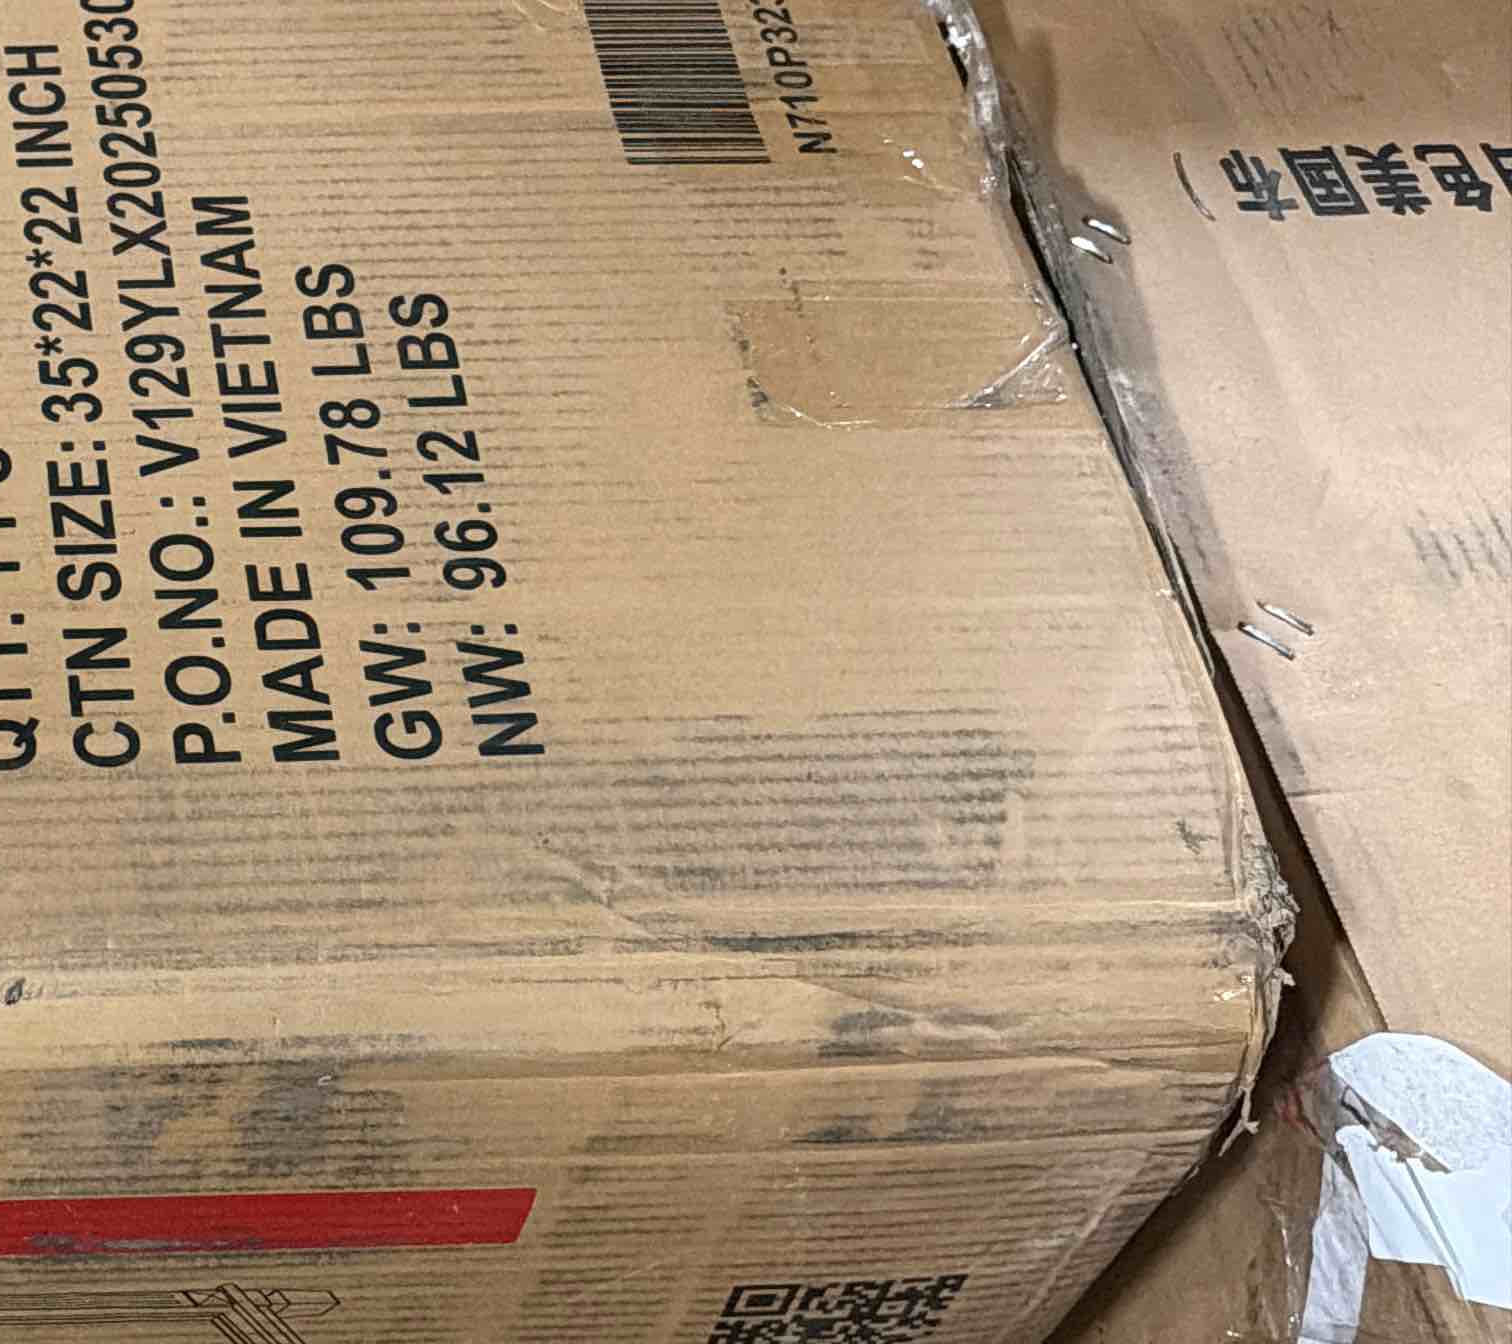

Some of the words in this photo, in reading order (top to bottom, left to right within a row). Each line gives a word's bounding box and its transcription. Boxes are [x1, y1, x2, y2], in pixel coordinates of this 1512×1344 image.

[3, 44, 74, 168] INCH
[191, 195, 288, 458] VIETNAM
[294, 262, 373, 377] LBS
[388, 292, 469, 408] LBS
[45, 440, 123, 602] SIZE:
[232, 479, 304, 538] IN
[318, 397, 411, 591] 109.78
[415, 429, 508, 591] 96.12
[61, 627, 141, 768] CTN
[148, 496, 243, 764] P.O.NO.:
[244, 562, 341, 763] MADE
[358, 622, 444, 760] GW:
[455, 622, 546, 757] NW:
